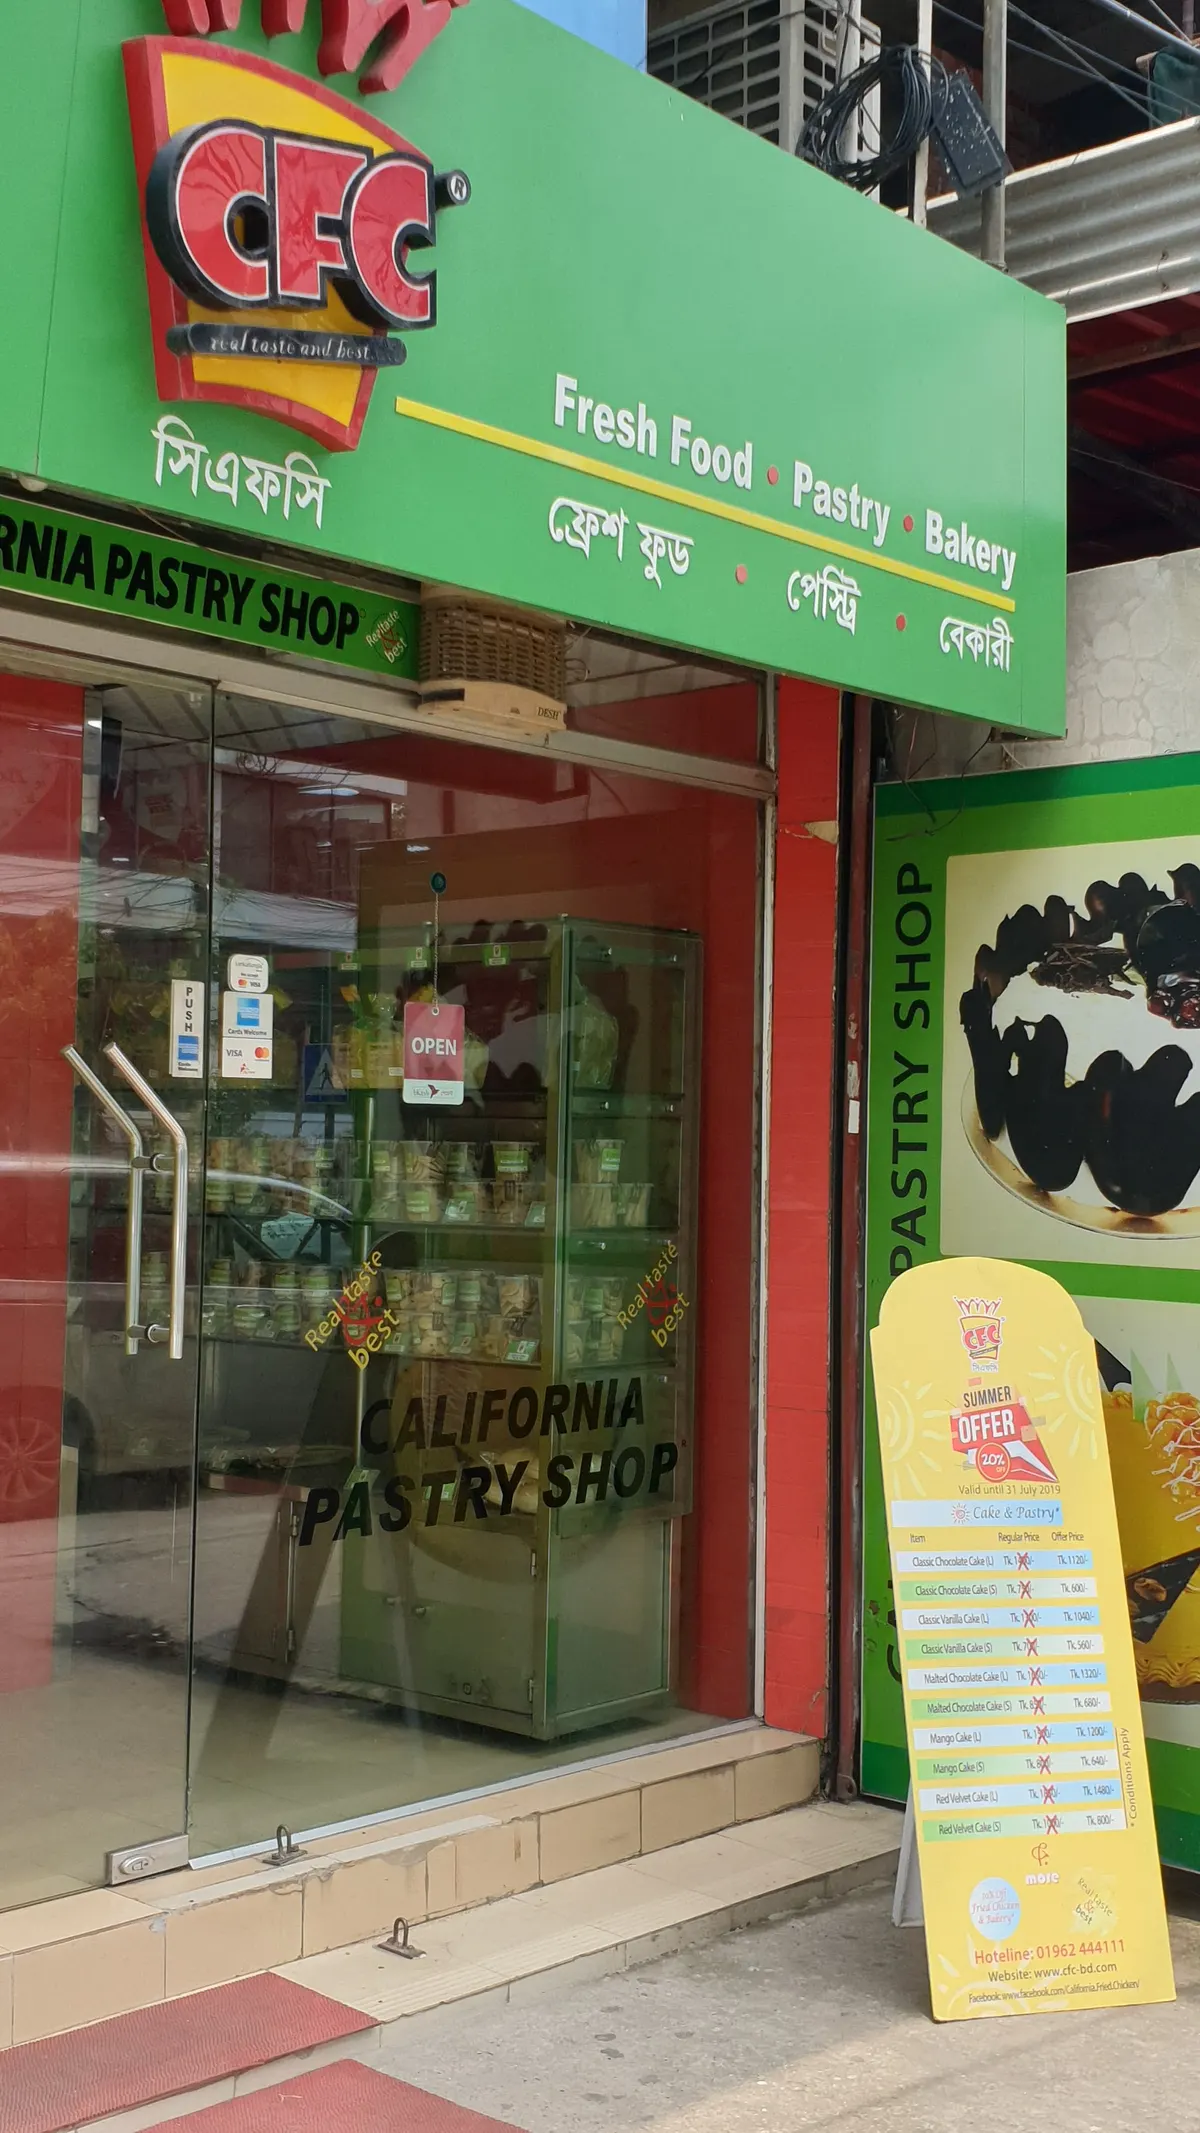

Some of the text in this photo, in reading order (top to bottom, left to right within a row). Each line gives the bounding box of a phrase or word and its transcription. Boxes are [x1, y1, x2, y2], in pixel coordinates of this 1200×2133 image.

[147, 118, 437, 330] CFC
[210, 330, 248, 352] real
[251, 338, 294, 355] taste
[301, 338, 332, 357] and
[151, 415, 331, 529] সিএফসি
[554, 372, 1017, 591] Fresh Food Pastry Bakery
[548, 497, 1014, 672] ফ্রেশ ফুড পেস্ট্রি বেকারী
[104, 542, 256, 626] PASTRY
[259, 582, 360, 650] SHOP
[384, 638, 407, 663] best
[538, 707, 559, 720] DESH
[412, 1037, 456, 1055] OPEN
[889, 862, 932, 1275] PASTRY SHOP
[617, 1244, 678, 1330] Real taste
[305, 1251, 382, 1352] Real taste
[651, 1292, 690, 1347] best
[348, 1309, 400, 1369] best
[964, 1325, 1001, 1350] CFC
[963, 1386, 1012, 1408] SUMMER
[360, 1376, 645, 1455] CALIFORNIA
[958, 1409, 1015, 1443] OFFER
[982, 1454, 1005, 1465] 20%
[299, 1441, 679, 1546] PASTRY SHOP
[958, 1485, 1061, 1496] Valid until 31 July 2019
[973, 1506, 1000, 1519] Cake
[1004, 1507, 1012, 1519] &
[910, 1532, 1084, 1544] Item Regular Price Offer Price
[913, 1557, 934, 1567] Classic
[935, 1556, 968, 1566] Chocolate
[969, 1556, 985, 1566] Cake
[1068, 1554, 1088, 1564] 1120/-
[916, 1585, 937, 1595] Classic
[938, 1584, 971, 1595] Chocolate
[972, 1584, 988, 1594] Cake
[1071, 1583, 1088, 1593] 600/-
[918, 1615, 940, 1624] Classic
[940, 1614, 963, 1624] Vanilla
[964, 1613, 980, 1624] Cake
[1074, 1611, 1094, 1621] 1040/-
[921, 1644, 943, 1654] Classic
[943, 1643, 966, 1653] Vanilla
[967, 1643, 983, 1653] Cake
[1077, 1640, 1094, 1650] 560/-
[924, 1673, 948, 1684] Malted
[949, 1673, 982, 1683] Chocolate
[983, 1672, 999, 1681] Cake
[1081, 1668, 1101, 1678] 1320/-
[927, 1703, 951, 1713] Malted
[952, 1702, 985, 1712] Chocolate
[986, 1701, 1002, 1711] Cake
[1084, 1697, 1100, 1708] 680/-
[930, 1733, 954, 1745] Mango
[955, 1732, 972, 1742] Cake
[1087, 1726, 1108, 1736] 1200/-
[933, 1764, 957, 1776] Mango
[959, 1762, 975, 1772] Cake
[1092, 1756, 1108, 1766] 640/-
[1120, 1728, 1137, 1819] Conditions Apply
[936, 1794, 949, 1804] Red
[950, 1793, 971, 1803] Velvet
[972, 1792, 988, 1802] Cake
[1094, 1785, 1114, 1795] 1480/-
[939, 1824, 952, 1835] Red
[953, 1823, 974, 1834] Velvet
[975, 1822, 992, 1833] Cake
[1097, 1814, 1114, 1825] 800/-
[1026, 1872, 1060, 1885] more
[1078, 1878, 1113, 1917] Real taste
[1075, 1904, 1092, 1925] best
[975, 1939, 1125, 1964] Hoteline: 01962 444111
[988, 1962, 1117, 1982] Website: www.cfc-bd.com
[969, 1993, 1001, 2003] Facebook:
